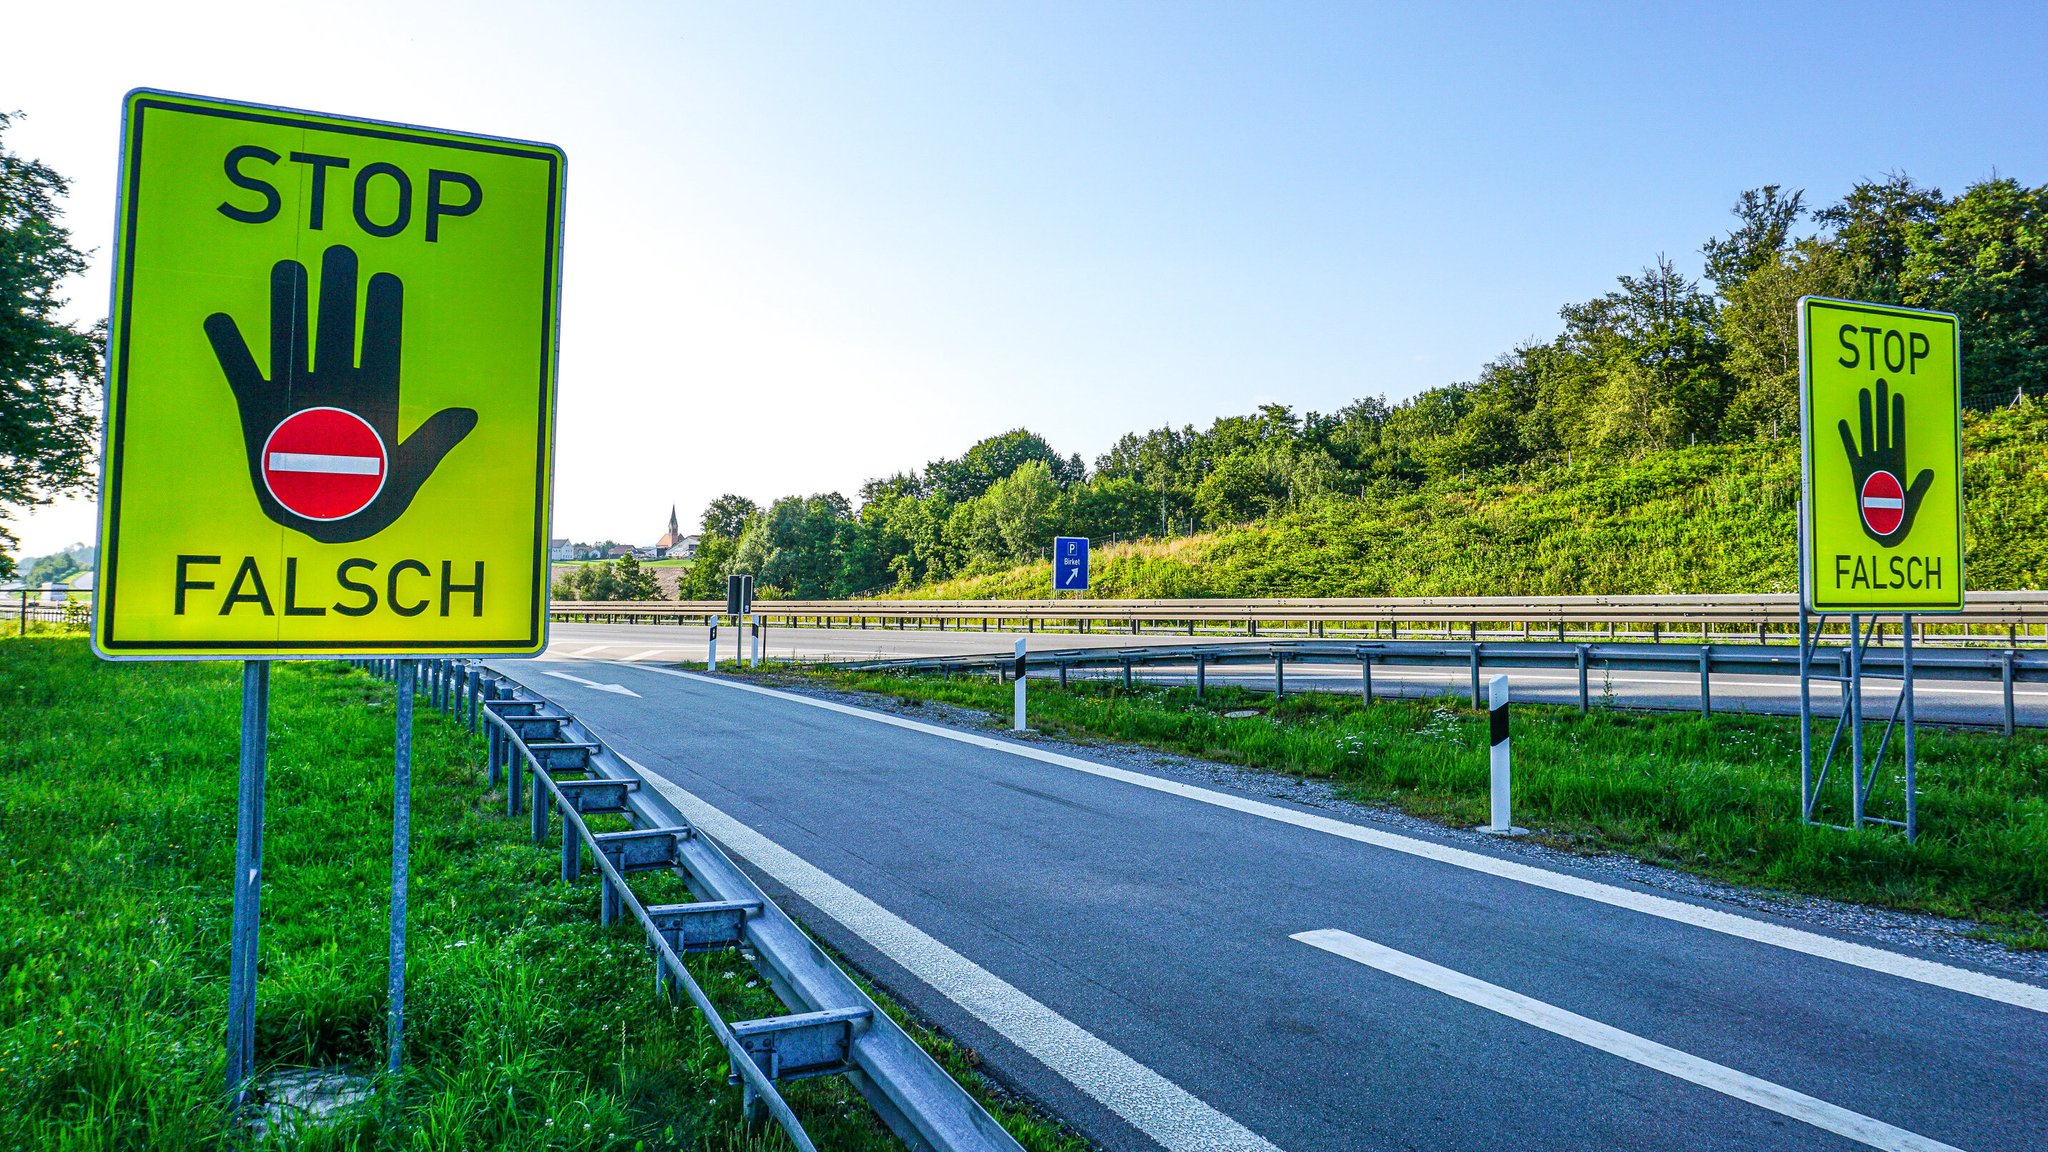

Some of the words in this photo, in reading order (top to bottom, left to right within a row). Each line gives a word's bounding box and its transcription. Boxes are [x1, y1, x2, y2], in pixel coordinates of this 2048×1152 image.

[217, 145, 483, 243] STOP
[1839, 324, 1930, 375] STOP
[174, 554, 485, 616] FALSCH
[1836, 555, 1942, 589] FALSCH
